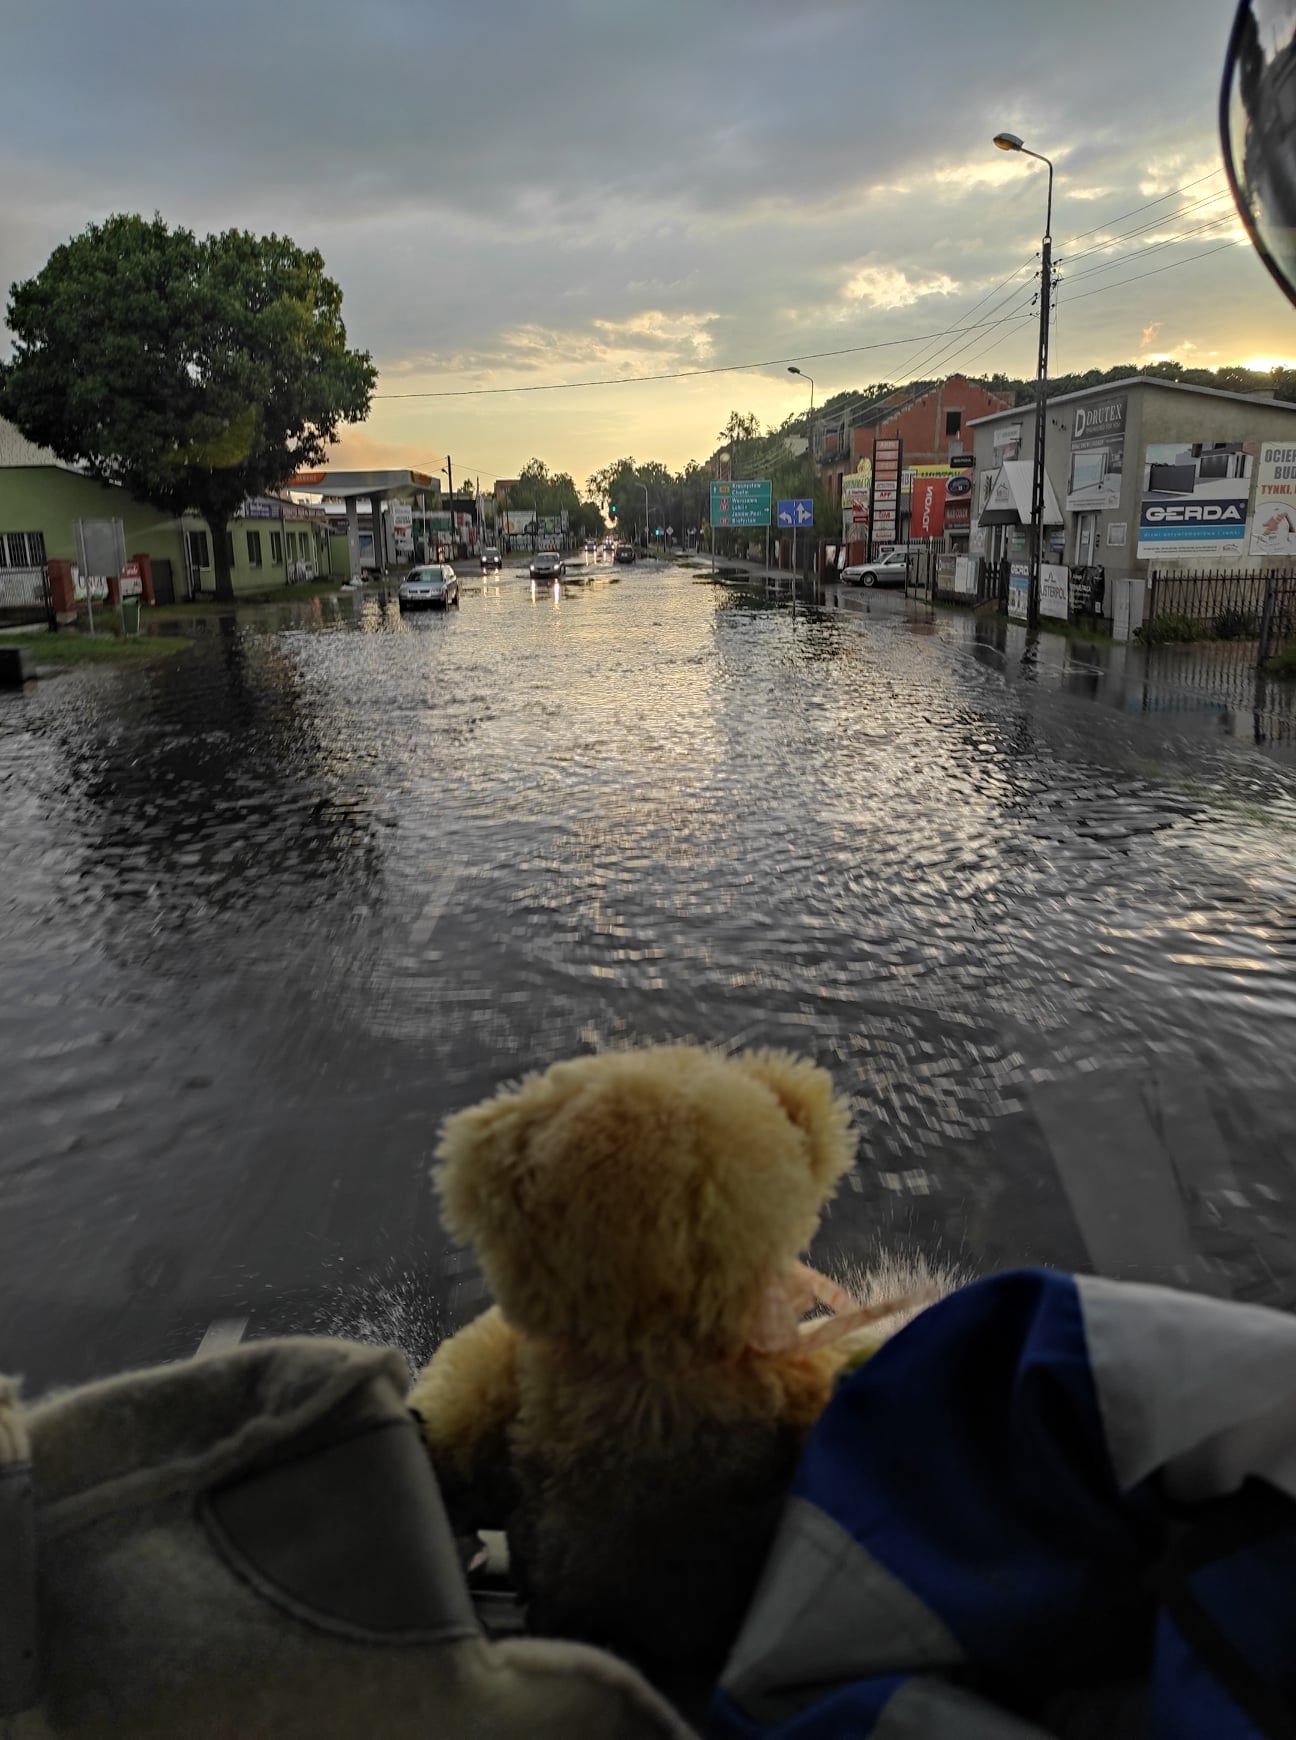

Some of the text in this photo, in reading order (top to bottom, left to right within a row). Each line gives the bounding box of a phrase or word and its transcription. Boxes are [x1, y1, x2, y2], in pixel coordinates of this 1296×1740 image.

[1087, 404, 1122, 426] DRUTEX
[1146, 505, 1241, 522] GERDA
[1011, 564, 1029, 576] GERD
